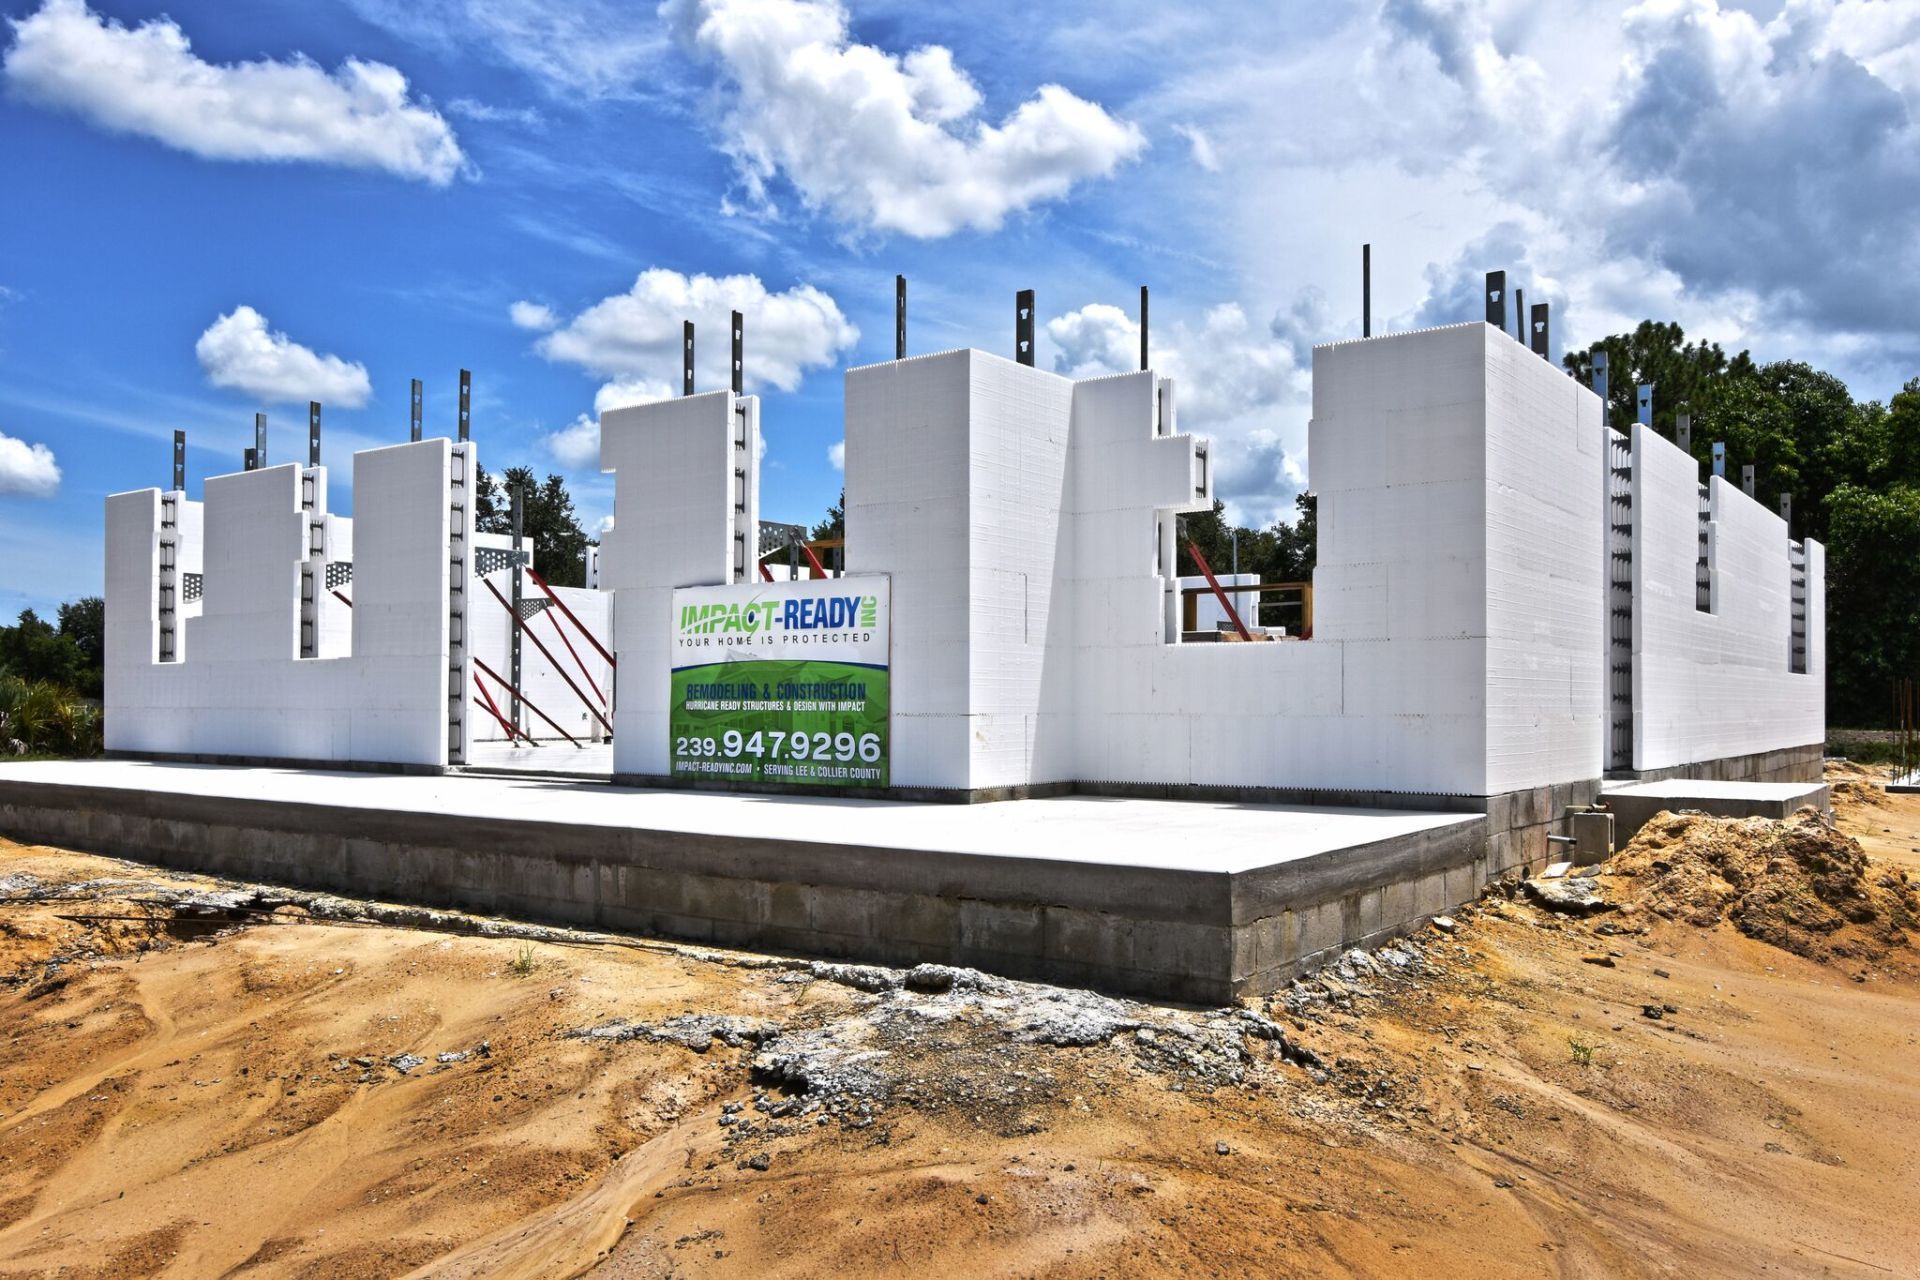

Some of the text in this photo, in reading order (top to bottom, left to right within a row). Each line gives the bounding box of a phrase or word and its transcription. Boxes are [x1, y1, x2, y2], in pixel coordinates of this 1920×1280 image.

[861, 595, 877, 627] INC
[680, 633, 870, 647] YOUR HOME IS PROTECTED
[687, 683, 866, 700] REMODELING & CONSTRUCTION
[686, 701, 866, 712] HURRICANE READY STRUCTURES & DESIGN WITH IMPACT
[676, 730, 881, 762] 239.947.9296
[676, 761, 881, 780] IMPACT-READYINC.COM SERVING LEE & COLLIER COUNTY
